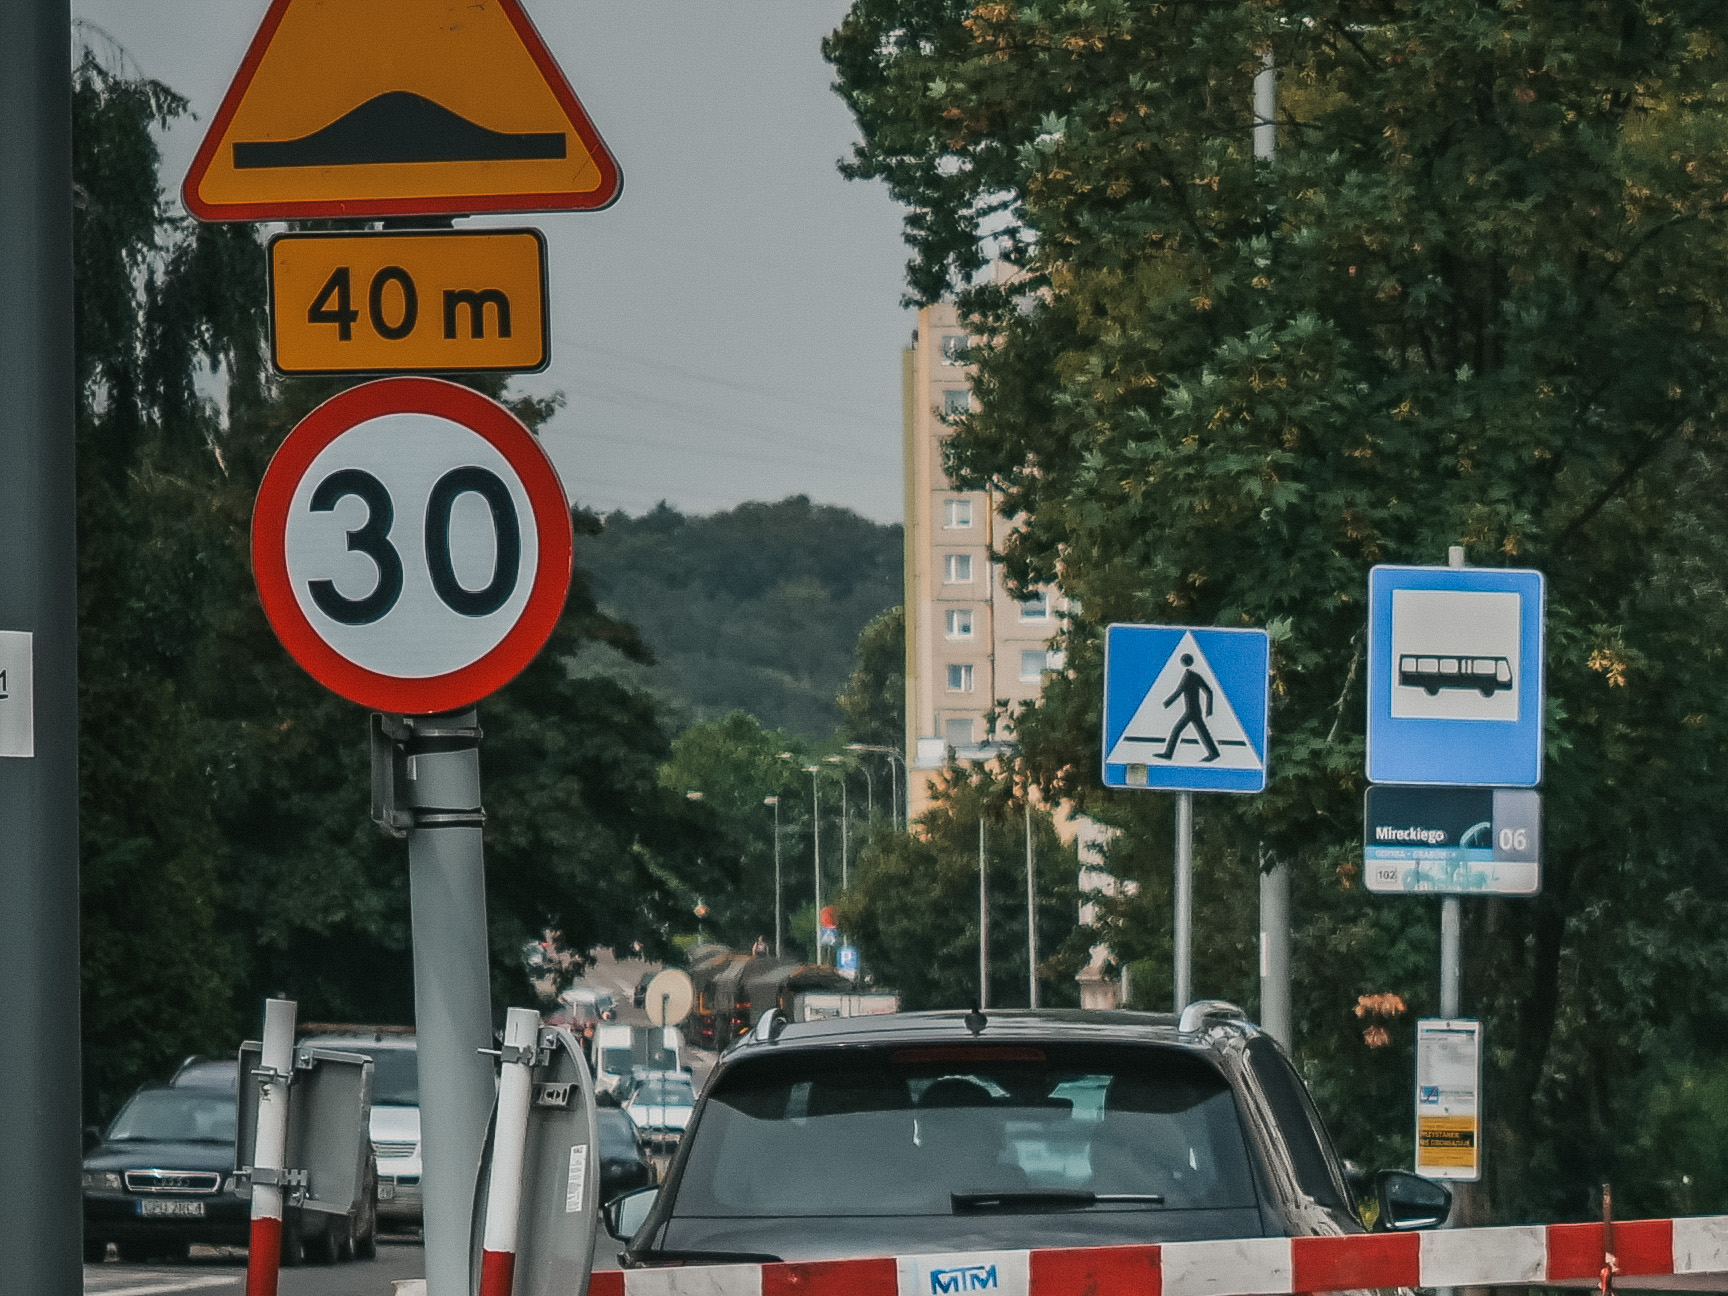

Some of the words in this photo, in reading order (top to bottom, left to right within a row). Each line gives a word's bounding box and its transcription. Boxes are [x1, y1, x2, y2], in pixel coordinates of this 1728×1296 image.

[308, 266, 418, 341] 40
[443, 289, 512, 339] m
[308, 466, 521, 626] 30
[1375, 826, 1447, 844] Mireckiego
[1498, 828, 1528, 851] 06
[1378, 870, 1396, 880] 102
[930, 1265, 997, 1294] MTM
